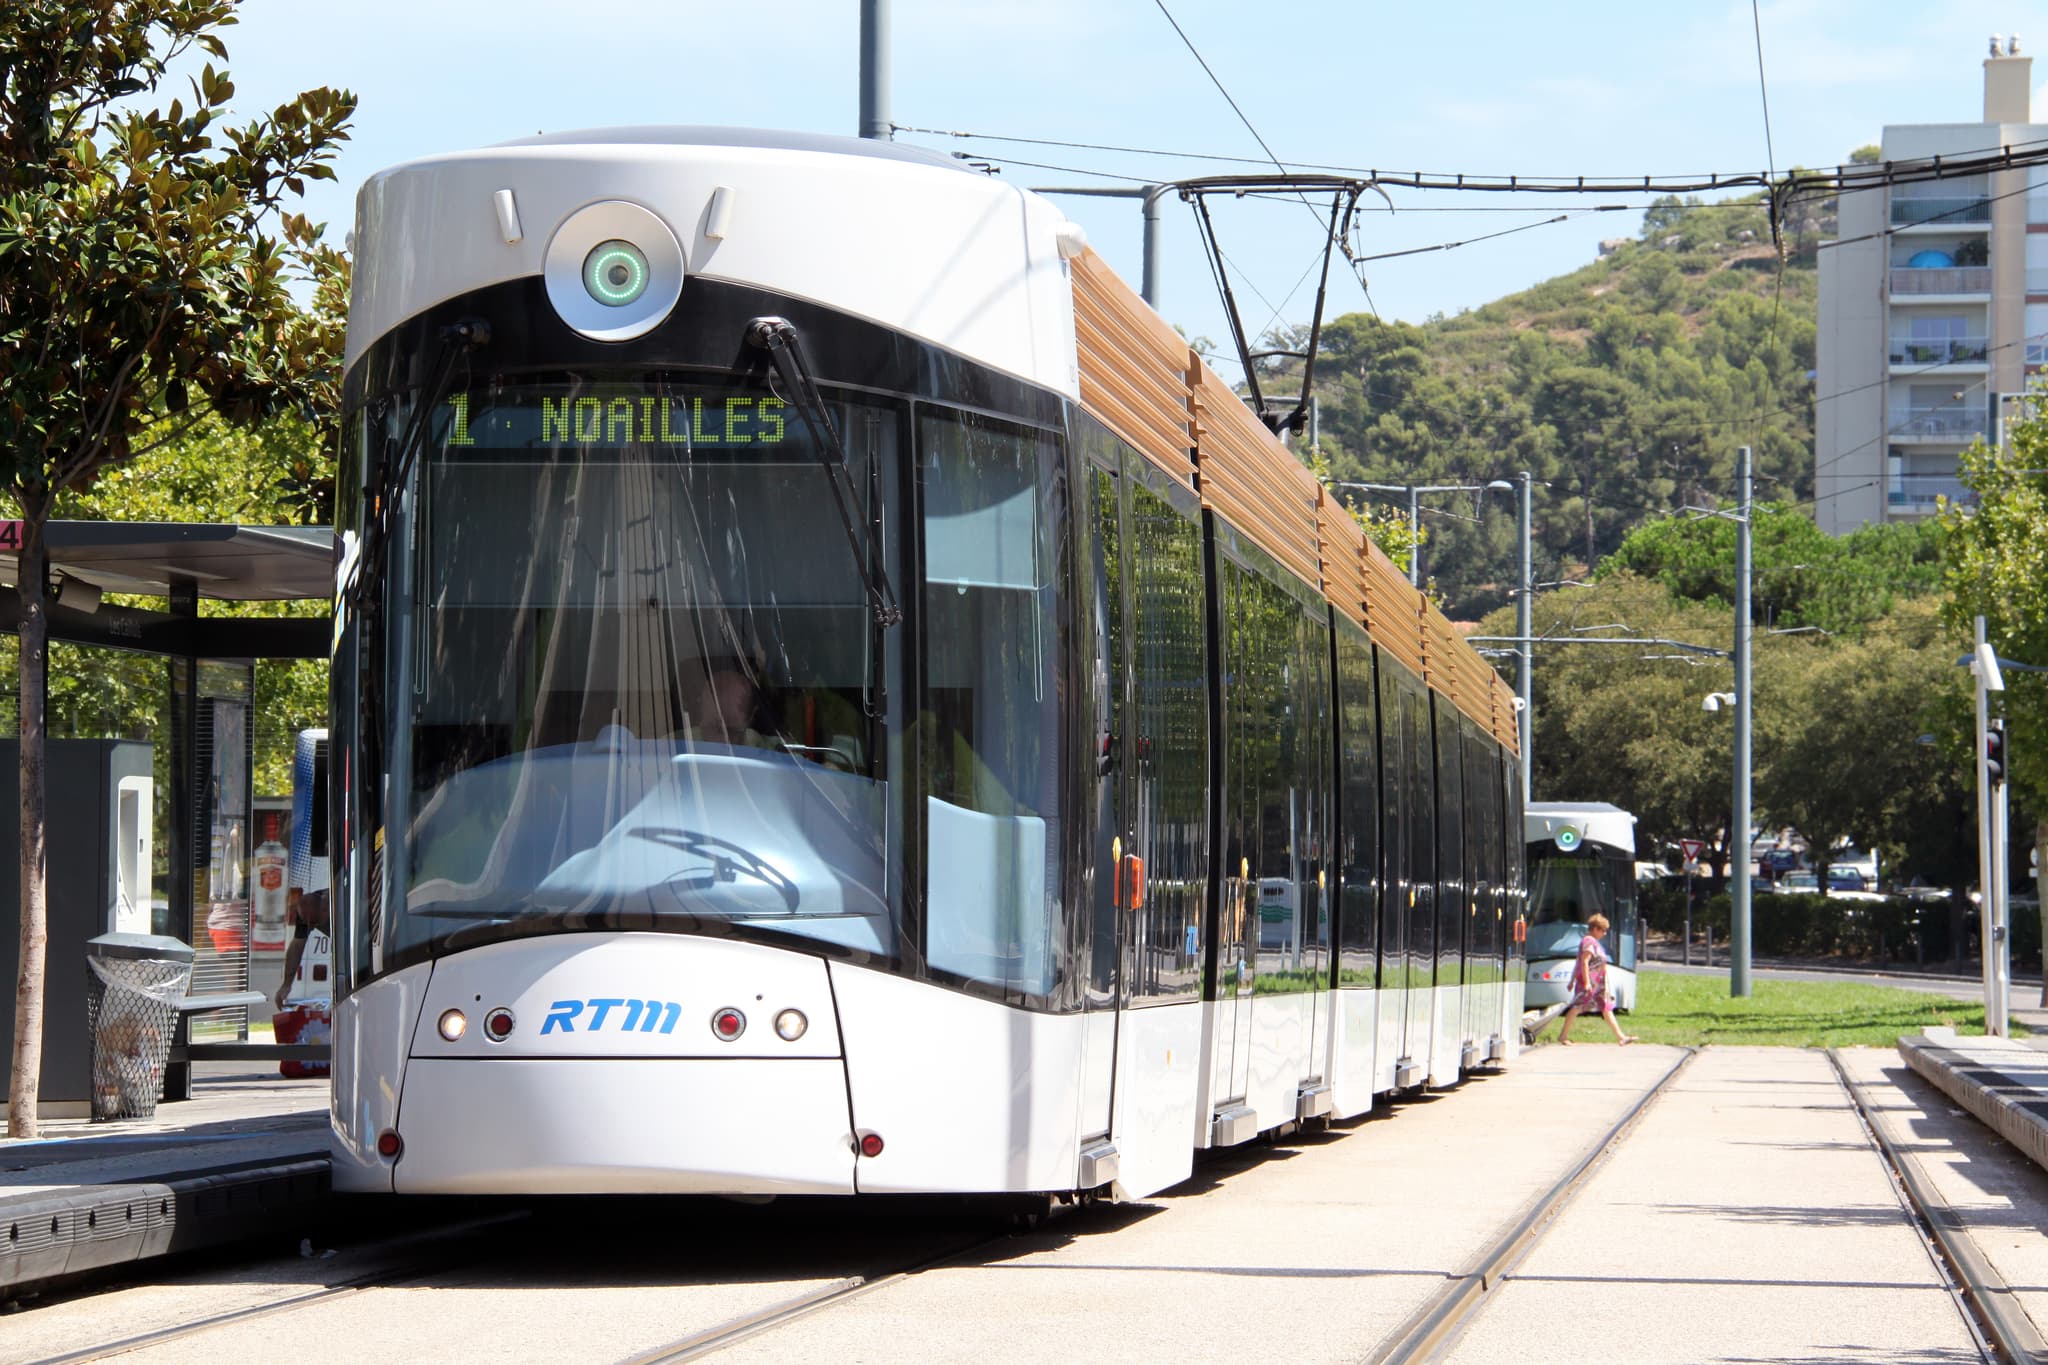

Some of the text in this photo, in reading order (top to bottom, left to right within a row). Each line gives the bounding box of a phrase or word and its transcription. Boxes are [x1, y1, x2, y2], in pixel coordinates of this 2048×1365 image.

[447, 393, 785, 445] 1 NOAILLES
[313, 936, 328, 954] 70
[540, 998, 682, 1036] RTM
